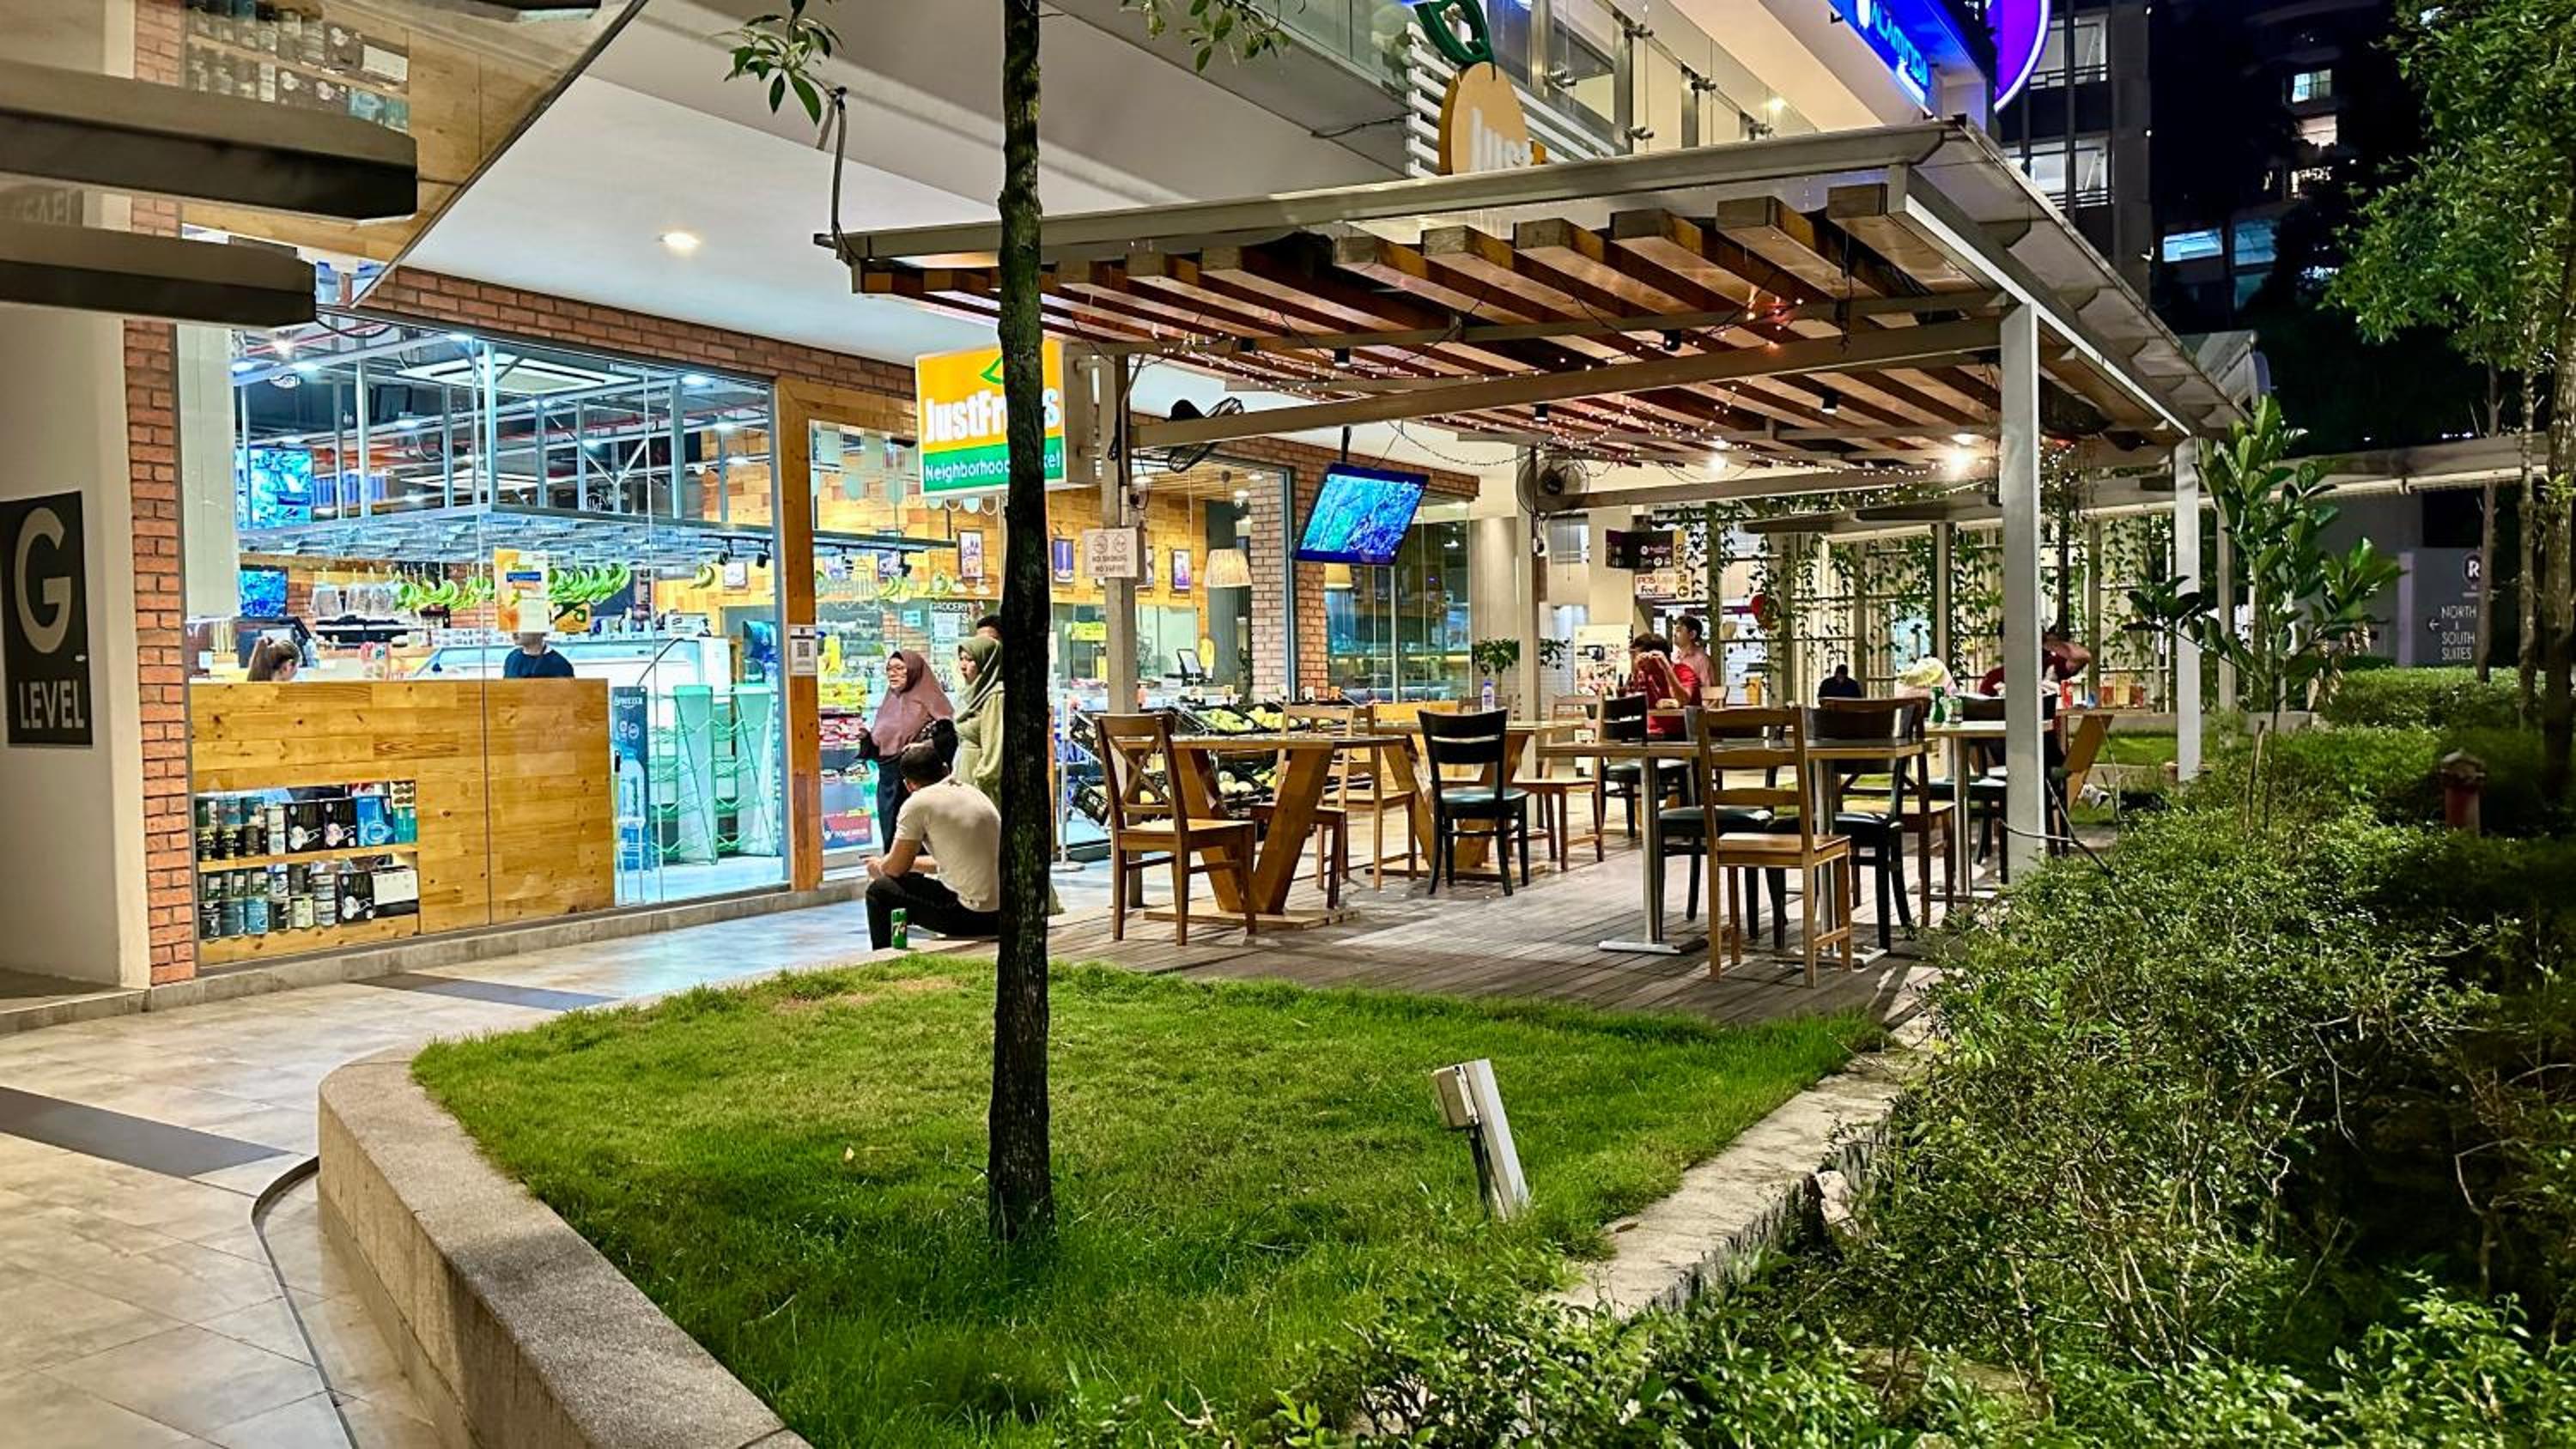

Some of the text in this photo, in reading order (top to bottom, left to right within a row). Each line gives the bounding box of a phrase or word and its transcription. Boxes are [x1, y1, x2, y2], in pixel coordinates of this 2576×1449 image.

[926, 388, 1060, 443] JustFrs
[2468, 560, 2480, 577] R
[14, 507, 71, 653] G
[2441, 605, 2477, 618] NORTH
[2441, 631, 2476, 645] SOUTH
[2441, 646, 2472, 660] SUITES
[19, 680, 84, 728] LEVEL
